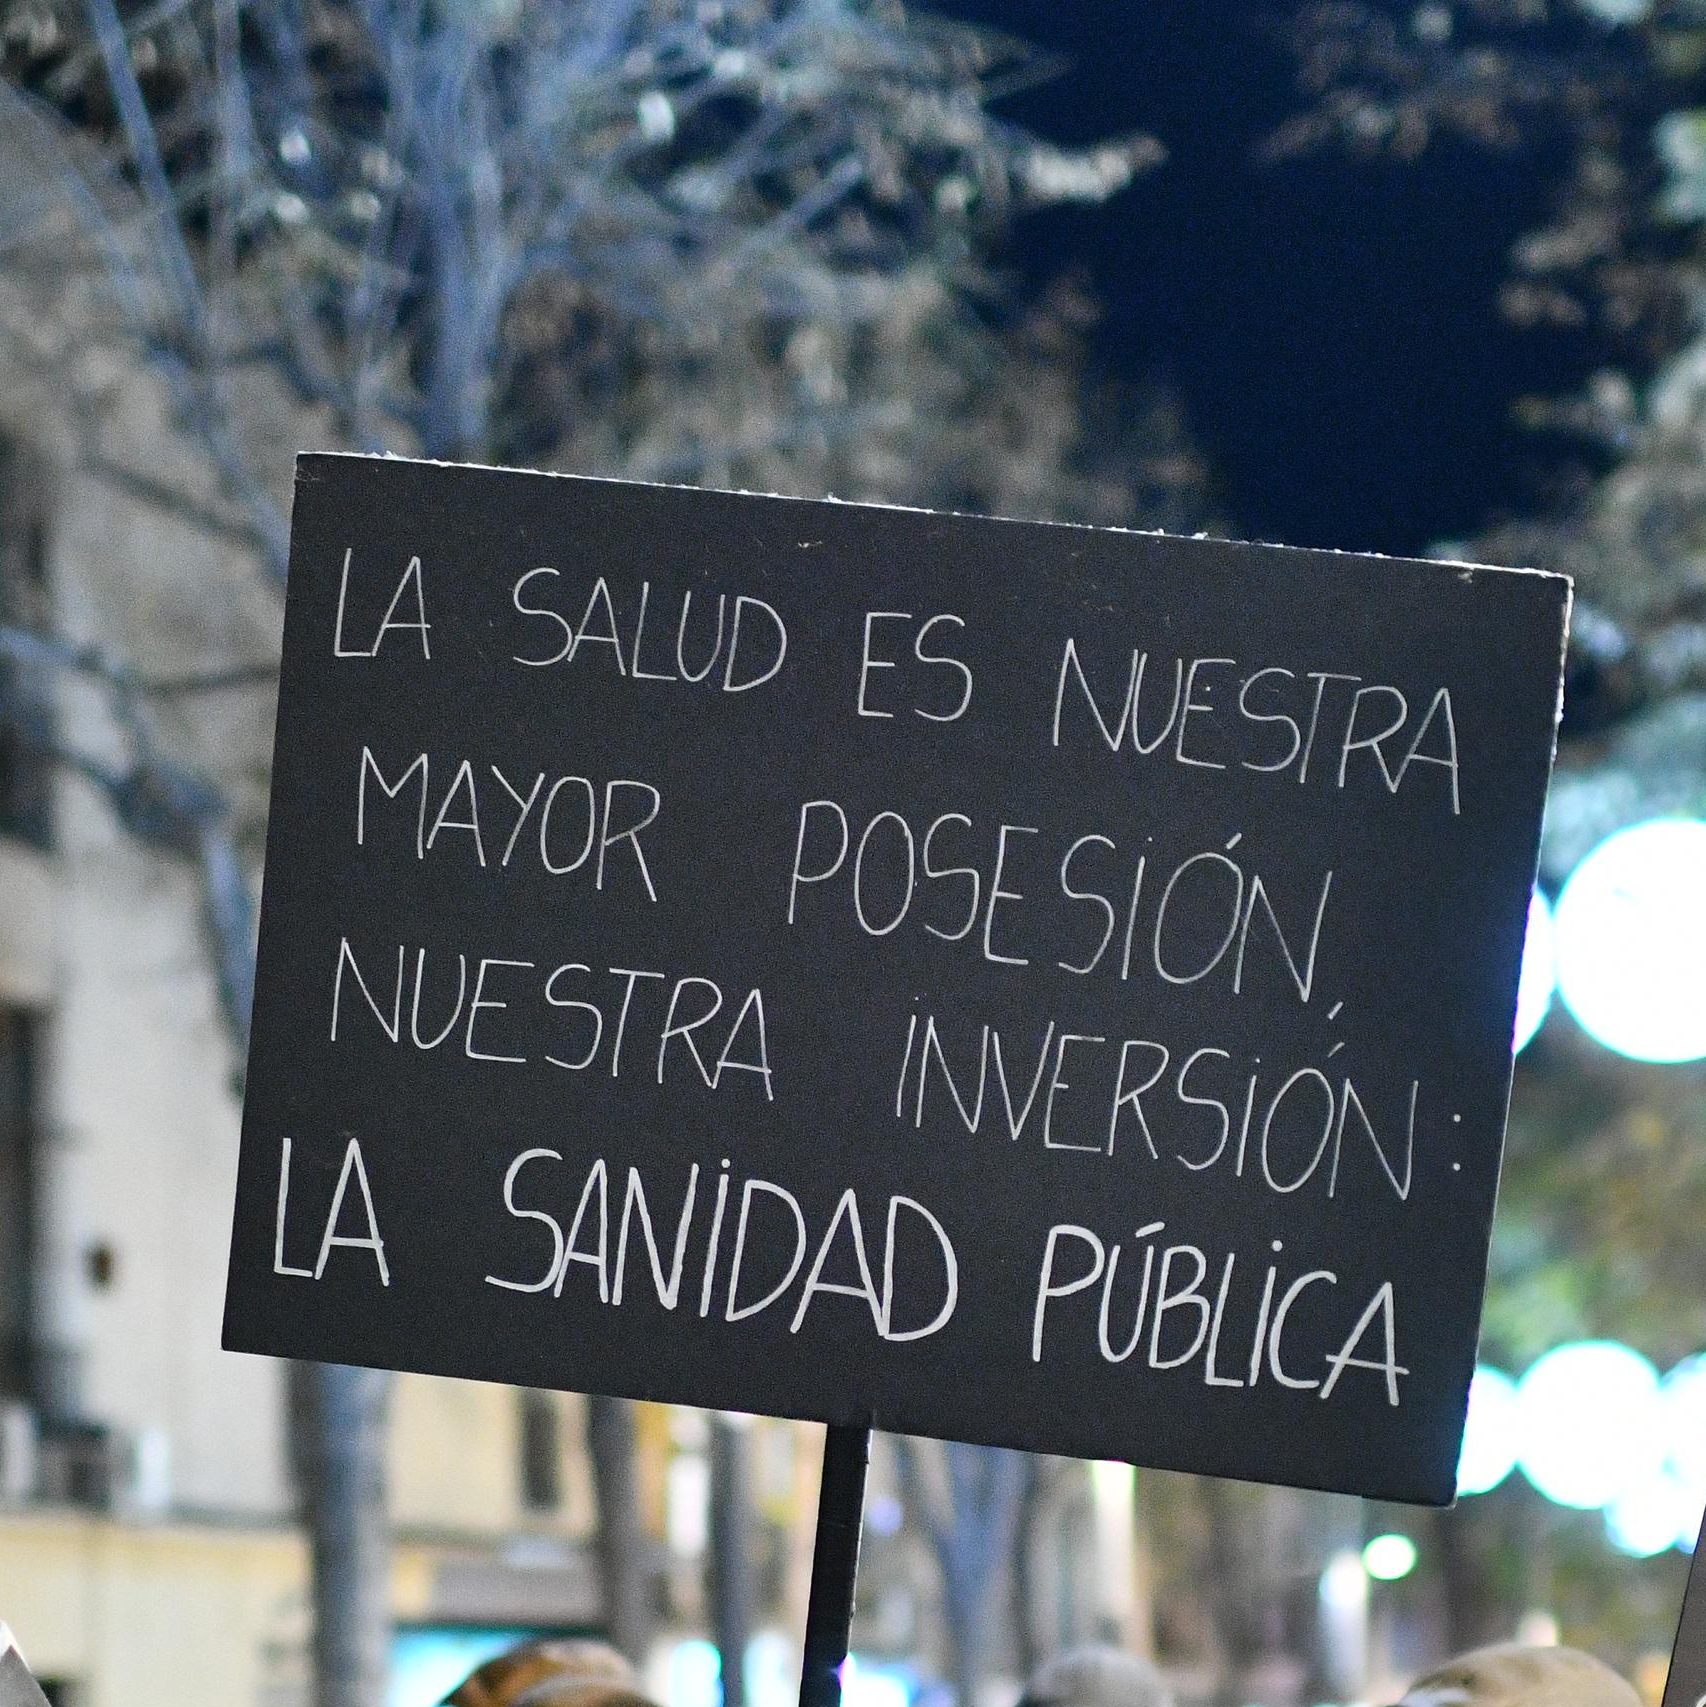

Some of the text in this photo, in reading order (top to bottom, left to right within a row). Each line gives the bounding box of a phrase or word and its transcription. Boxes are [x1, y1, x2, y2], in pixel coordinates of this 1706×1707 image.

[332, 546, 1461, 816] LA SALUD ES NUESTRA
[357, 744, 659, 903] MAYOR
[330, 936, 774, 1102] NUESTRA
[273, 1136, 1411, 1407] LA SANIDAD PÚBLICA
